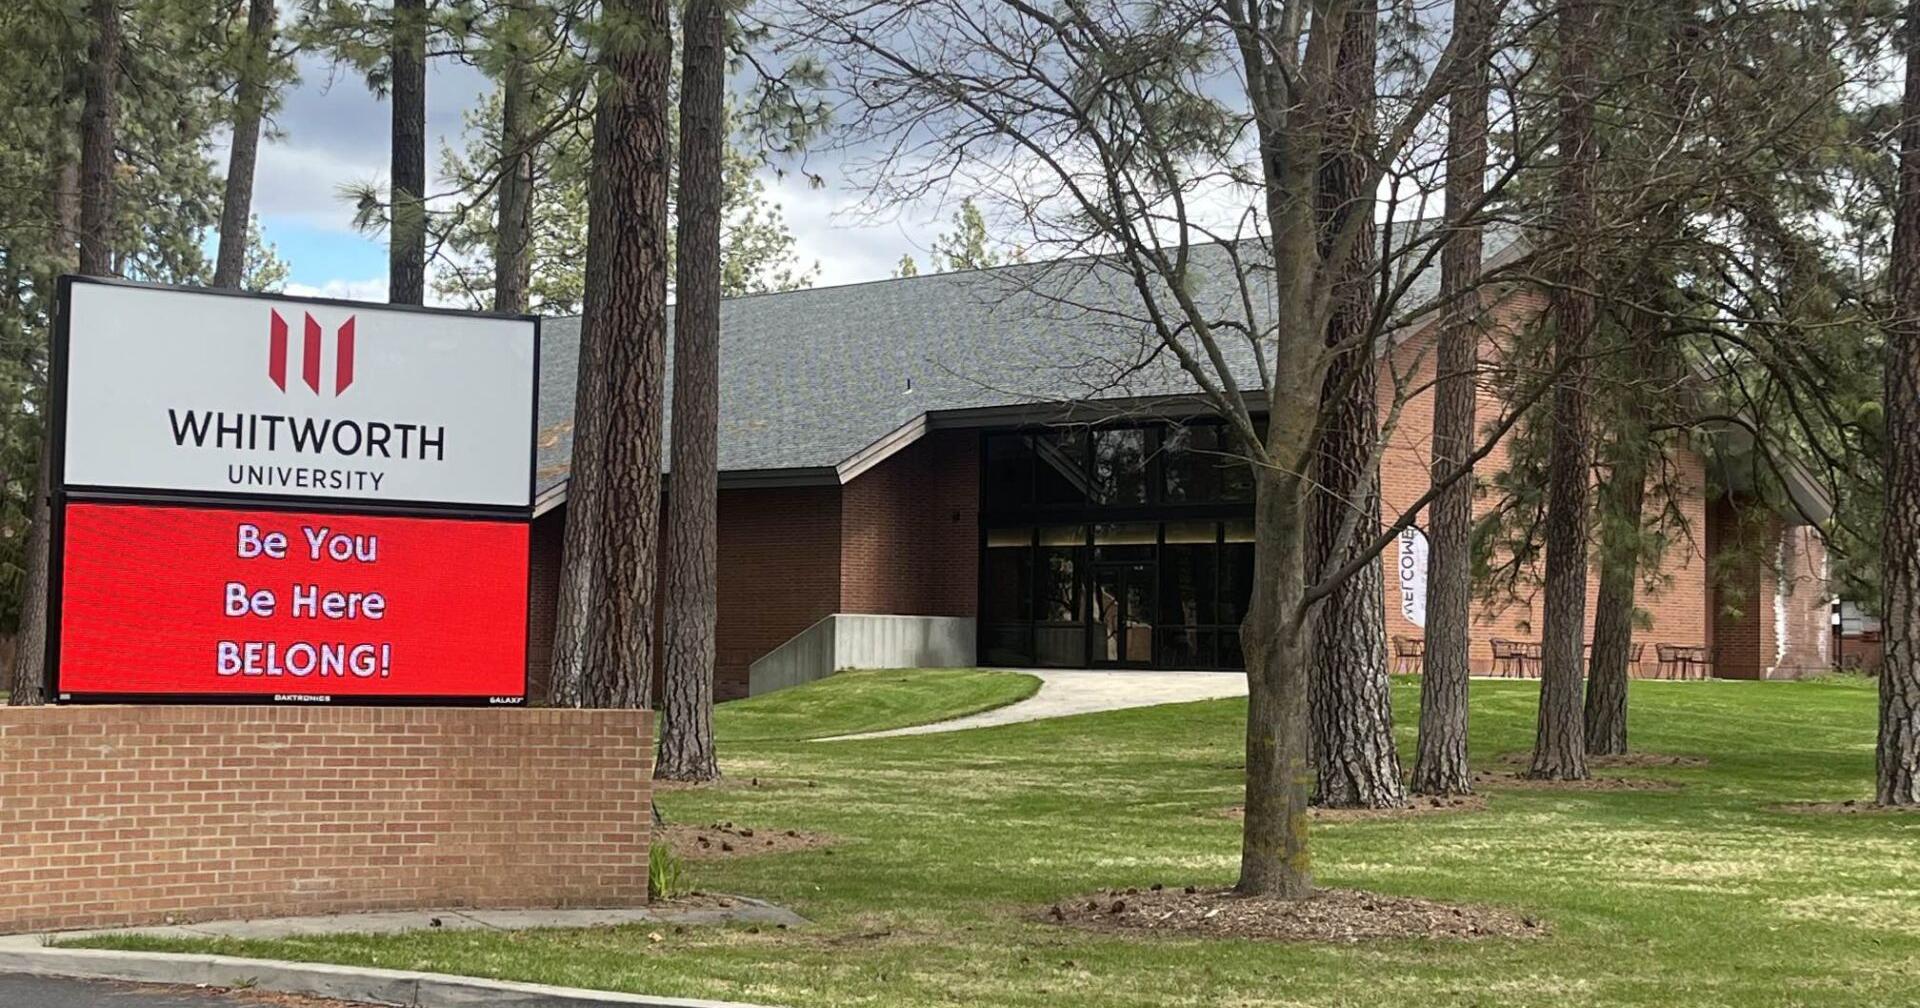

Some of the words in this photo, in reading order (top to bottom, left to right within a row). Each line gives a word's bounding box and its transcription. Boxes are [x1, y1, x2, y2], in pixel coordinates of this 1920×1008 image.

[168, 409, 445, 461] WHITWORTH
[228, 464, 385, 492] UNIVERSITY
[236, 523, 288, 560] Be
[304, 526, 379, 564] You
[224, 582, 276, 618] Be
[292, 585, 386, 621] Here
[216, 641, 392, 678] BELONG!
